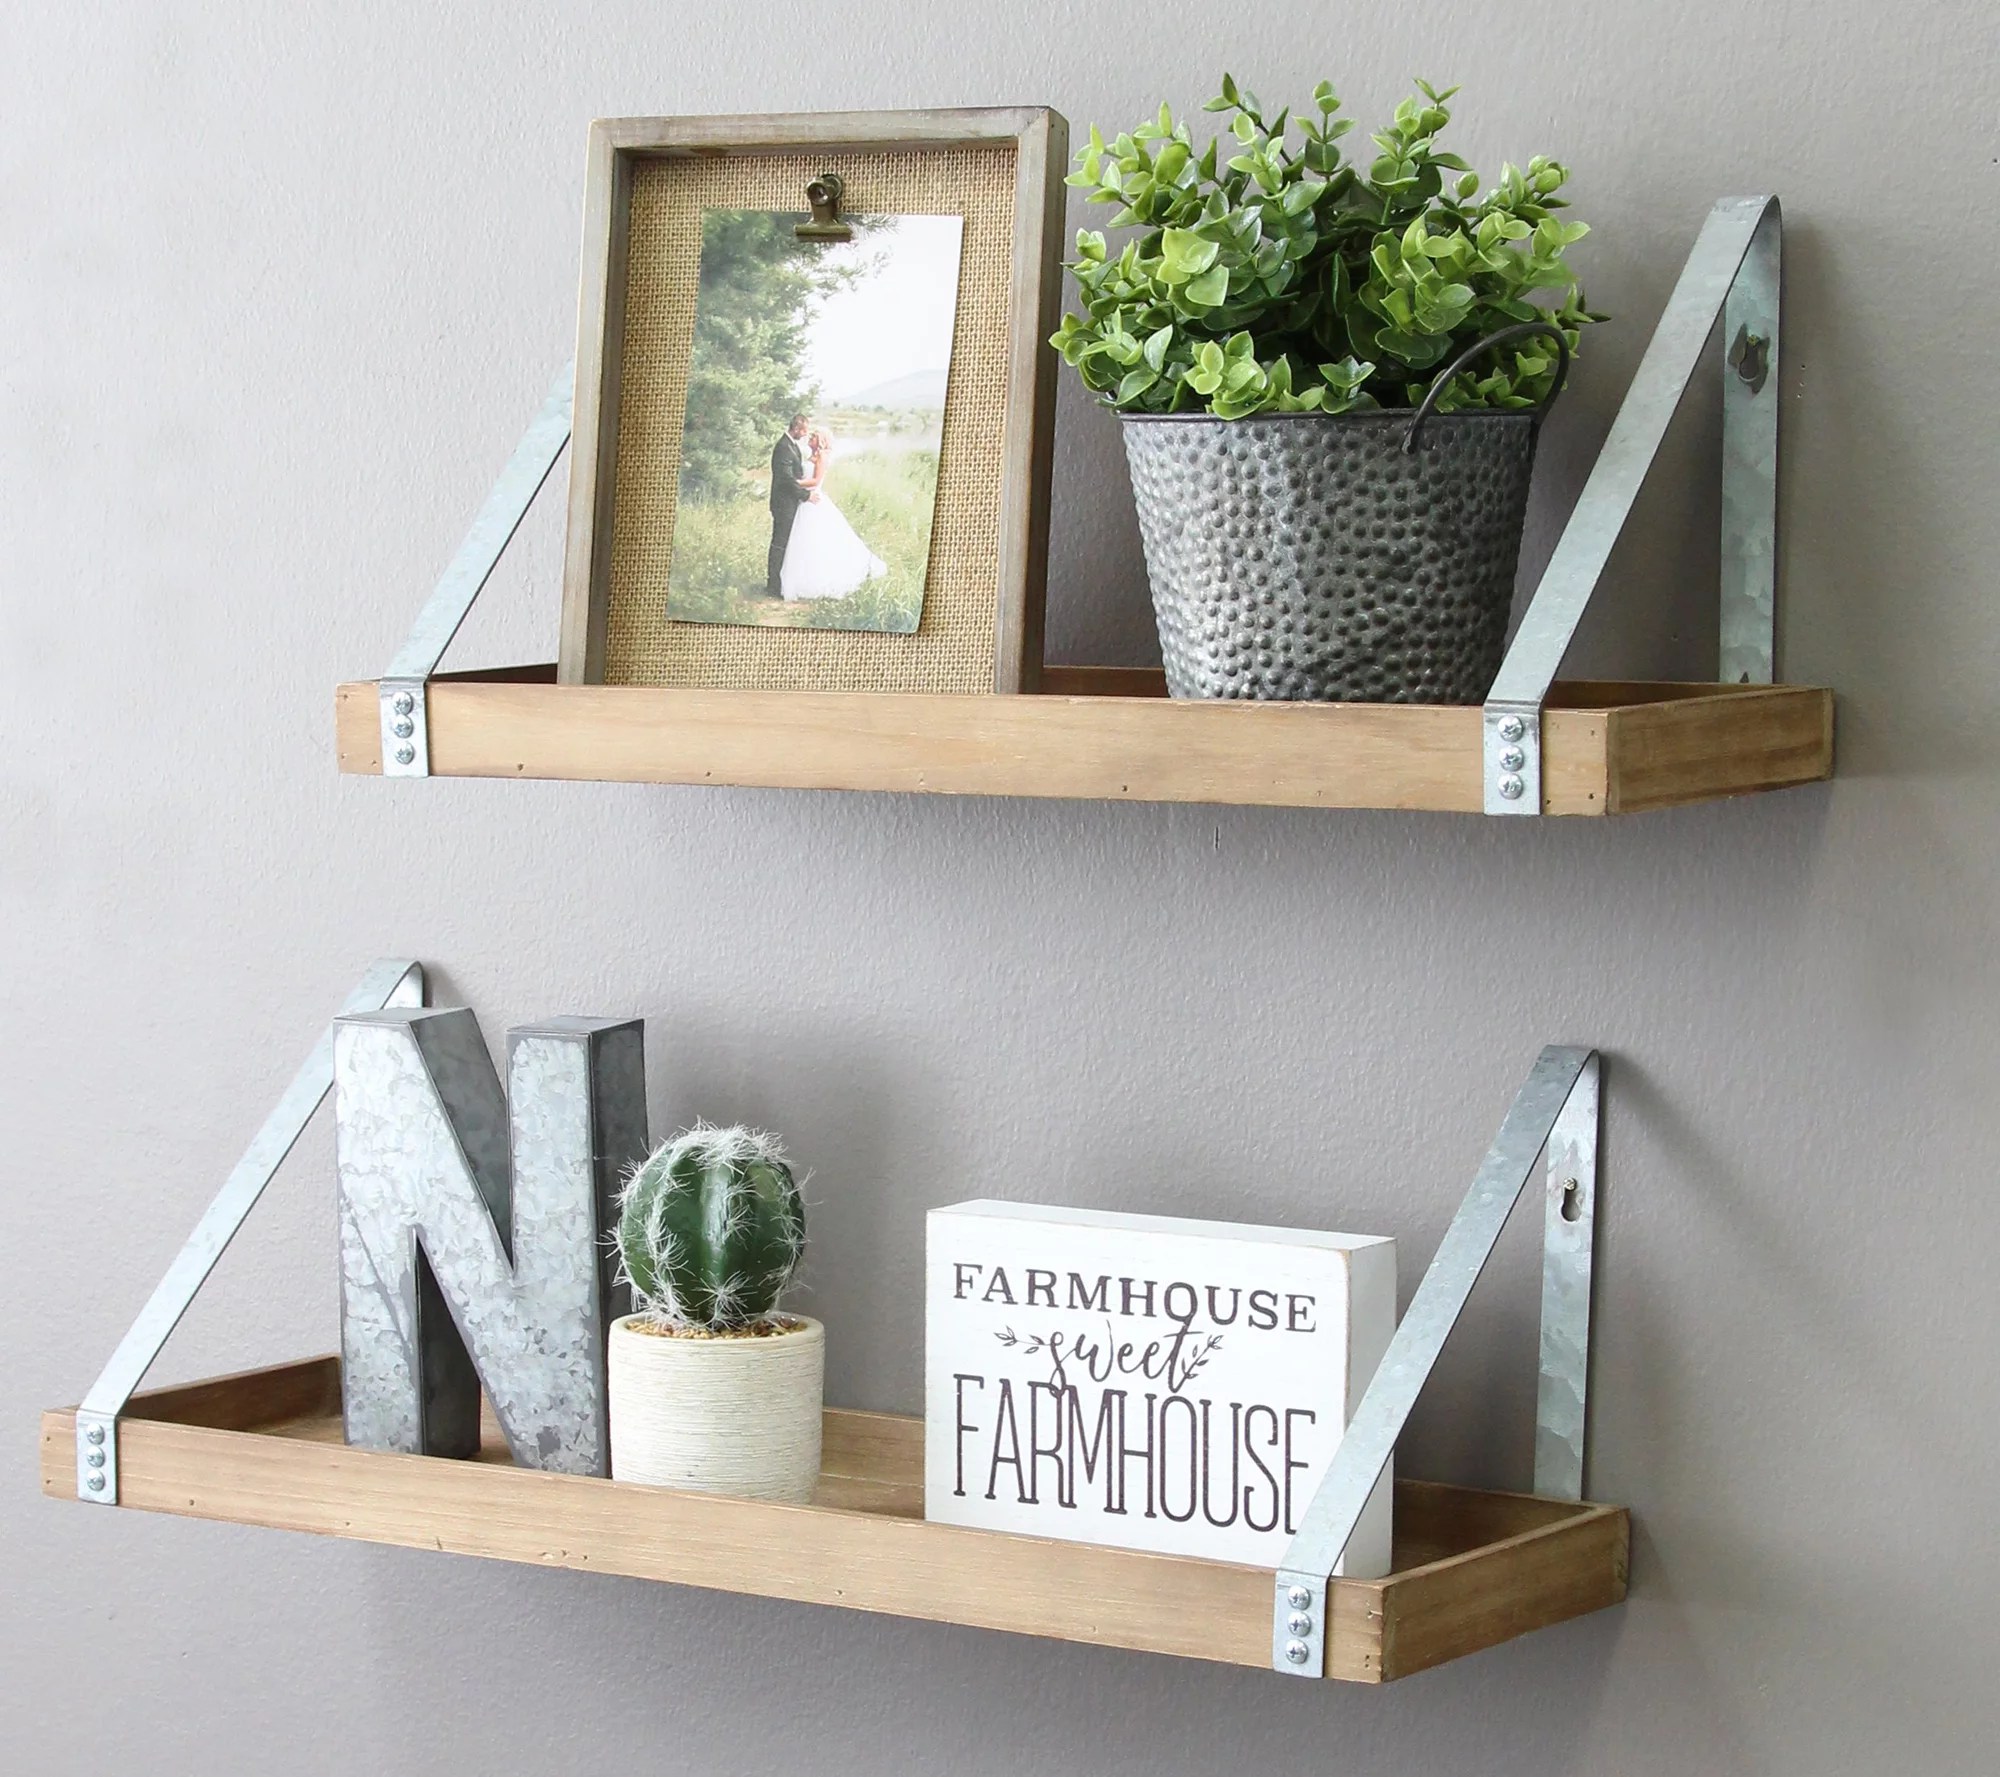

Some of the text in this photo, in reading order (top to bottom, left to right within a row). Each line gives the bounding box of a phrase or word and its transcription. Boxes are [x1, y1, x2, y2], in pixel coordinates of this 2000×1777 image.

[333, 1016, 612, 1478] N
[953, 1262, 1317, 1334] FARMHOUSE
[1048, 1314, 1204, 1398] sweet
[953, 1373, 1317, 1535] FARMHOUSE
